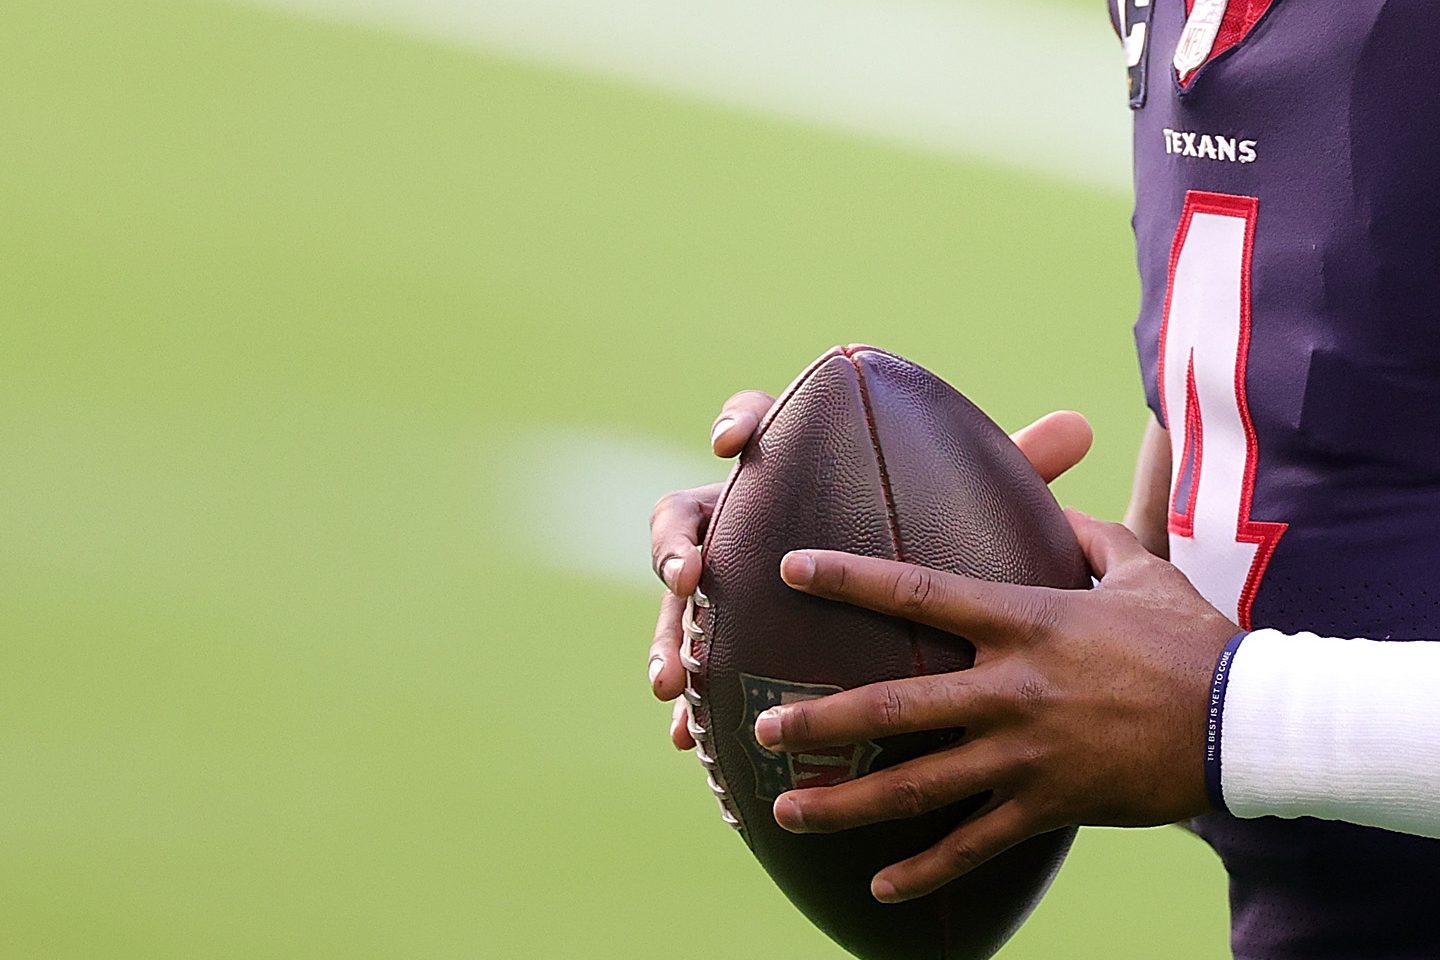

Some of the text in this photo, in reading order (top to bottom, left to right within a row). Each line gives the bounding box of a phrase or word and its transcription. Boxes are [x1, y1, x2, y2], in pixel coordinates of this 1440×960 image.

[1163, 128, 1258, 164] TEXANS
[1157, 189, 1290, 634] 4
[1207, 651, 1232, 761] THE BEST IS YET TO COME
